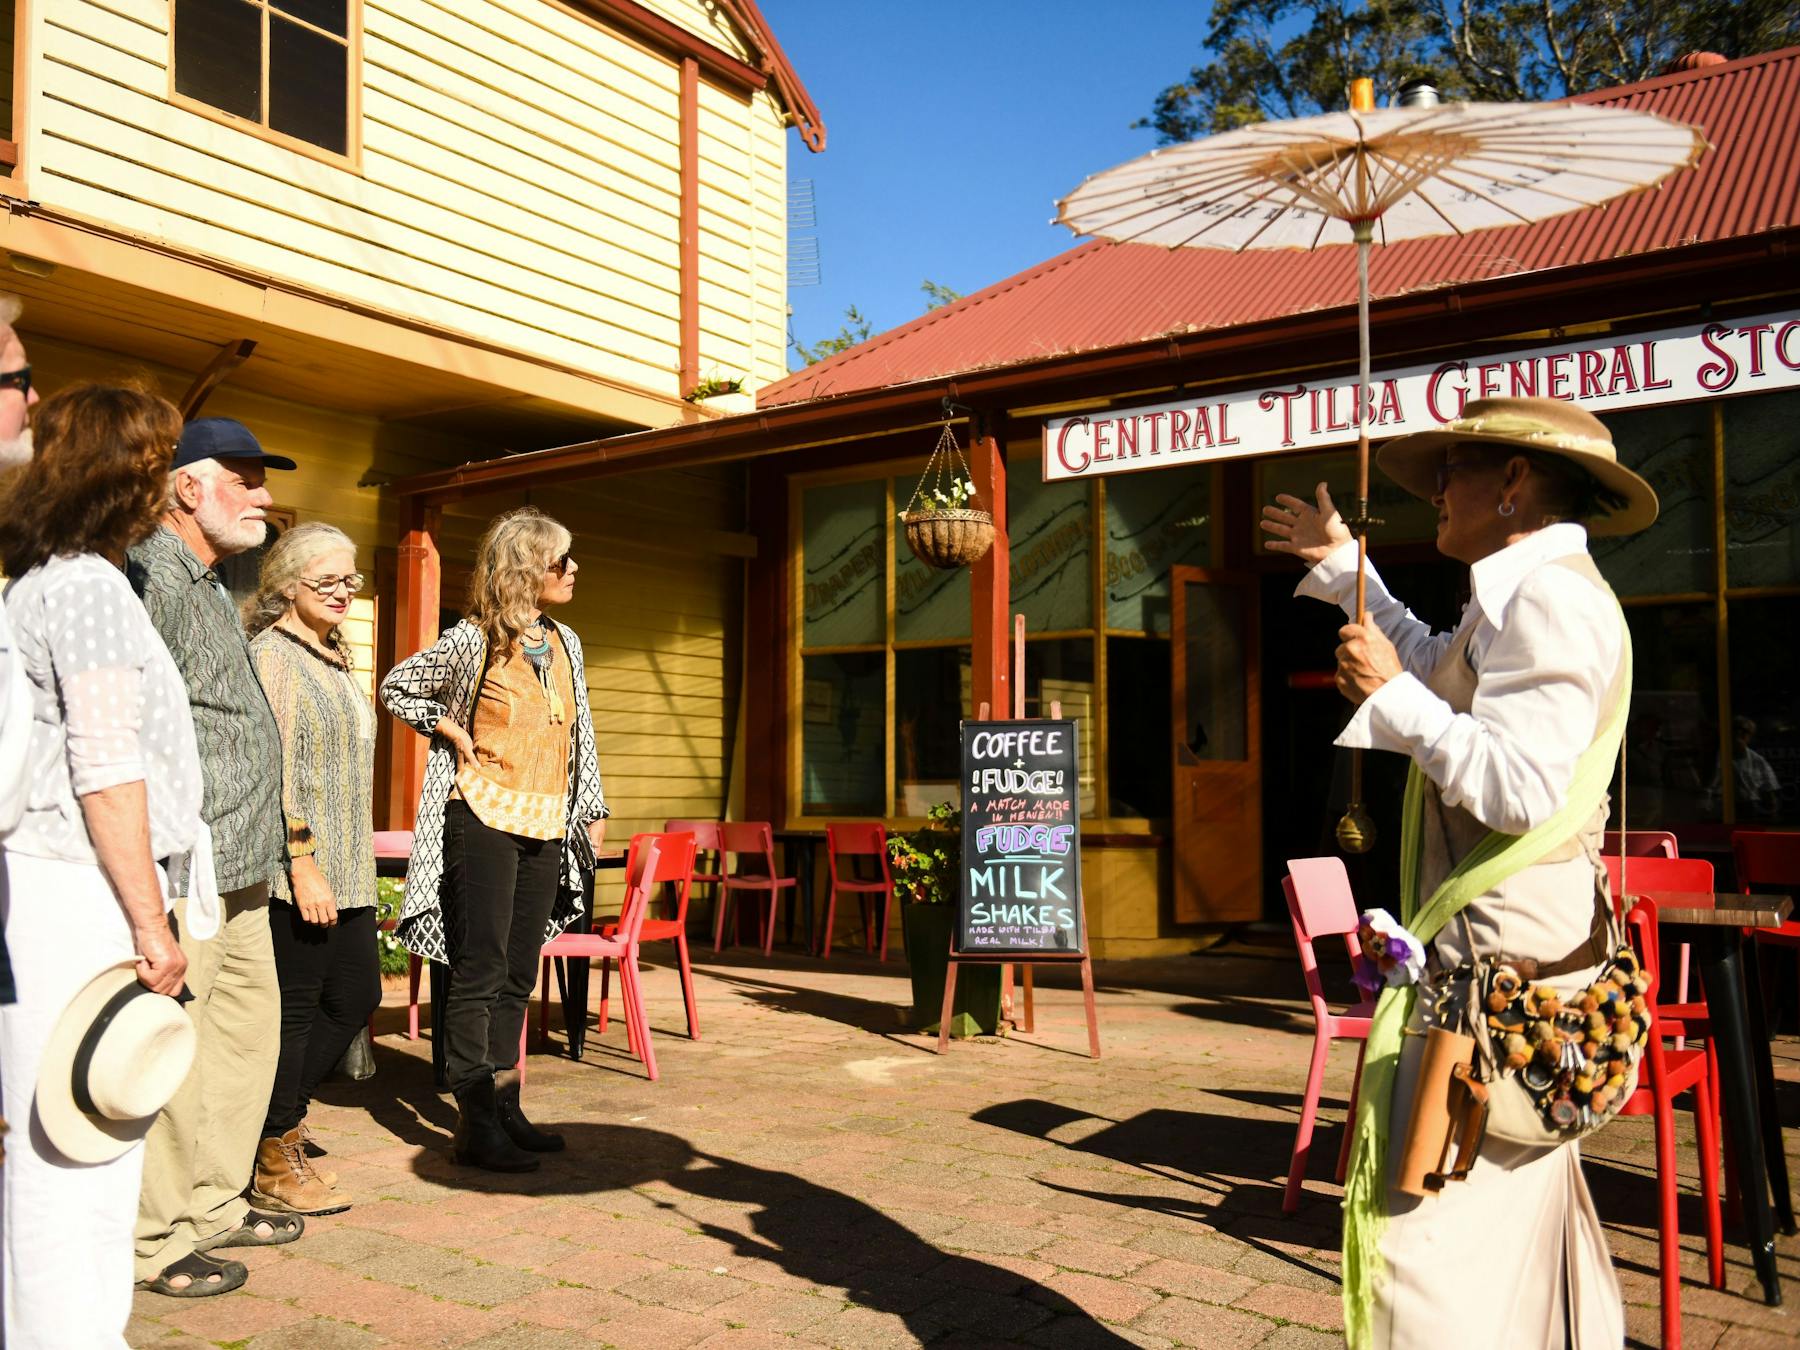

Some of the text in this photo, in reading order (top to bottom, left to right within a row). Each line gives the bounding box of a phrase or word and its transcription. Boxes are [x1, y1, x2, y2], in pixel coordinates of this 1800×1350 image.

[1056, 402, 1240, 473] CENTRAL
[1258, 378, 1405, 447] TILBA
[1426, 341, 1672, 425] GENERAL
[972, 731, 1064, 760] COFFEE
[971, 768, 1064, 795] !FUDGE!
[970, 797, 1070, 813] A MATCH MADE
[992, 812, 1003, 823] IN
[976, 825, 1074, 855] FUDGE
[970, 865, 1067, 900] MILK
[970, 902, 1075, 929] SHAKES
[968, 925, 994, 934] MADE
[998, 925, 1020, 934] WITH
[974, 936, 1002, 945] REAL
